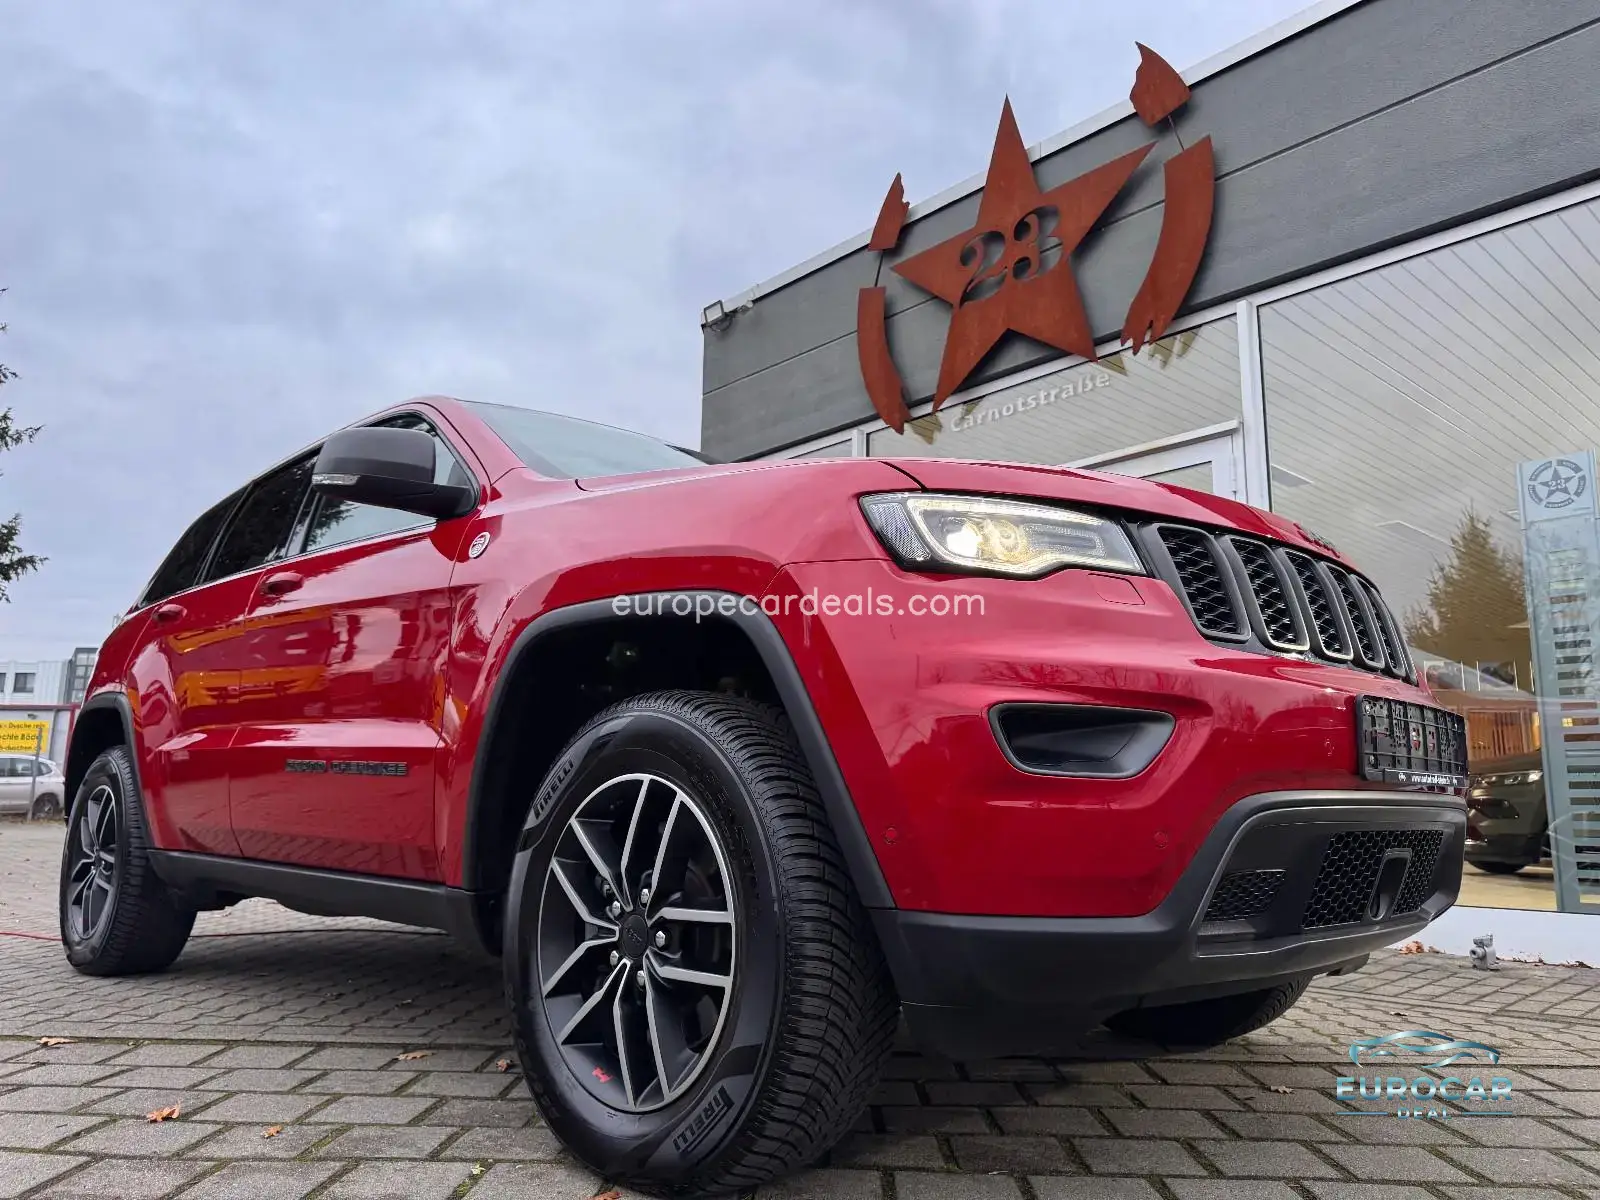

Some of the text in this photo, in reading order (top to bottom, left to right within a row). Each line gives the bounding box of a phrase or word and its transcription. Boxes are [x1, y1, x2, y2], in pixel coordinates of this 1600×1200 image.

[959, 204, 1063, 309] 23
[950, 371, 1112, 432] Carnotstraße
[1548, 478, 1566, 490] 23
[532, 753, 574, 820] PIRELLI
[672, 1084, 735, 1154] PIRELLI
